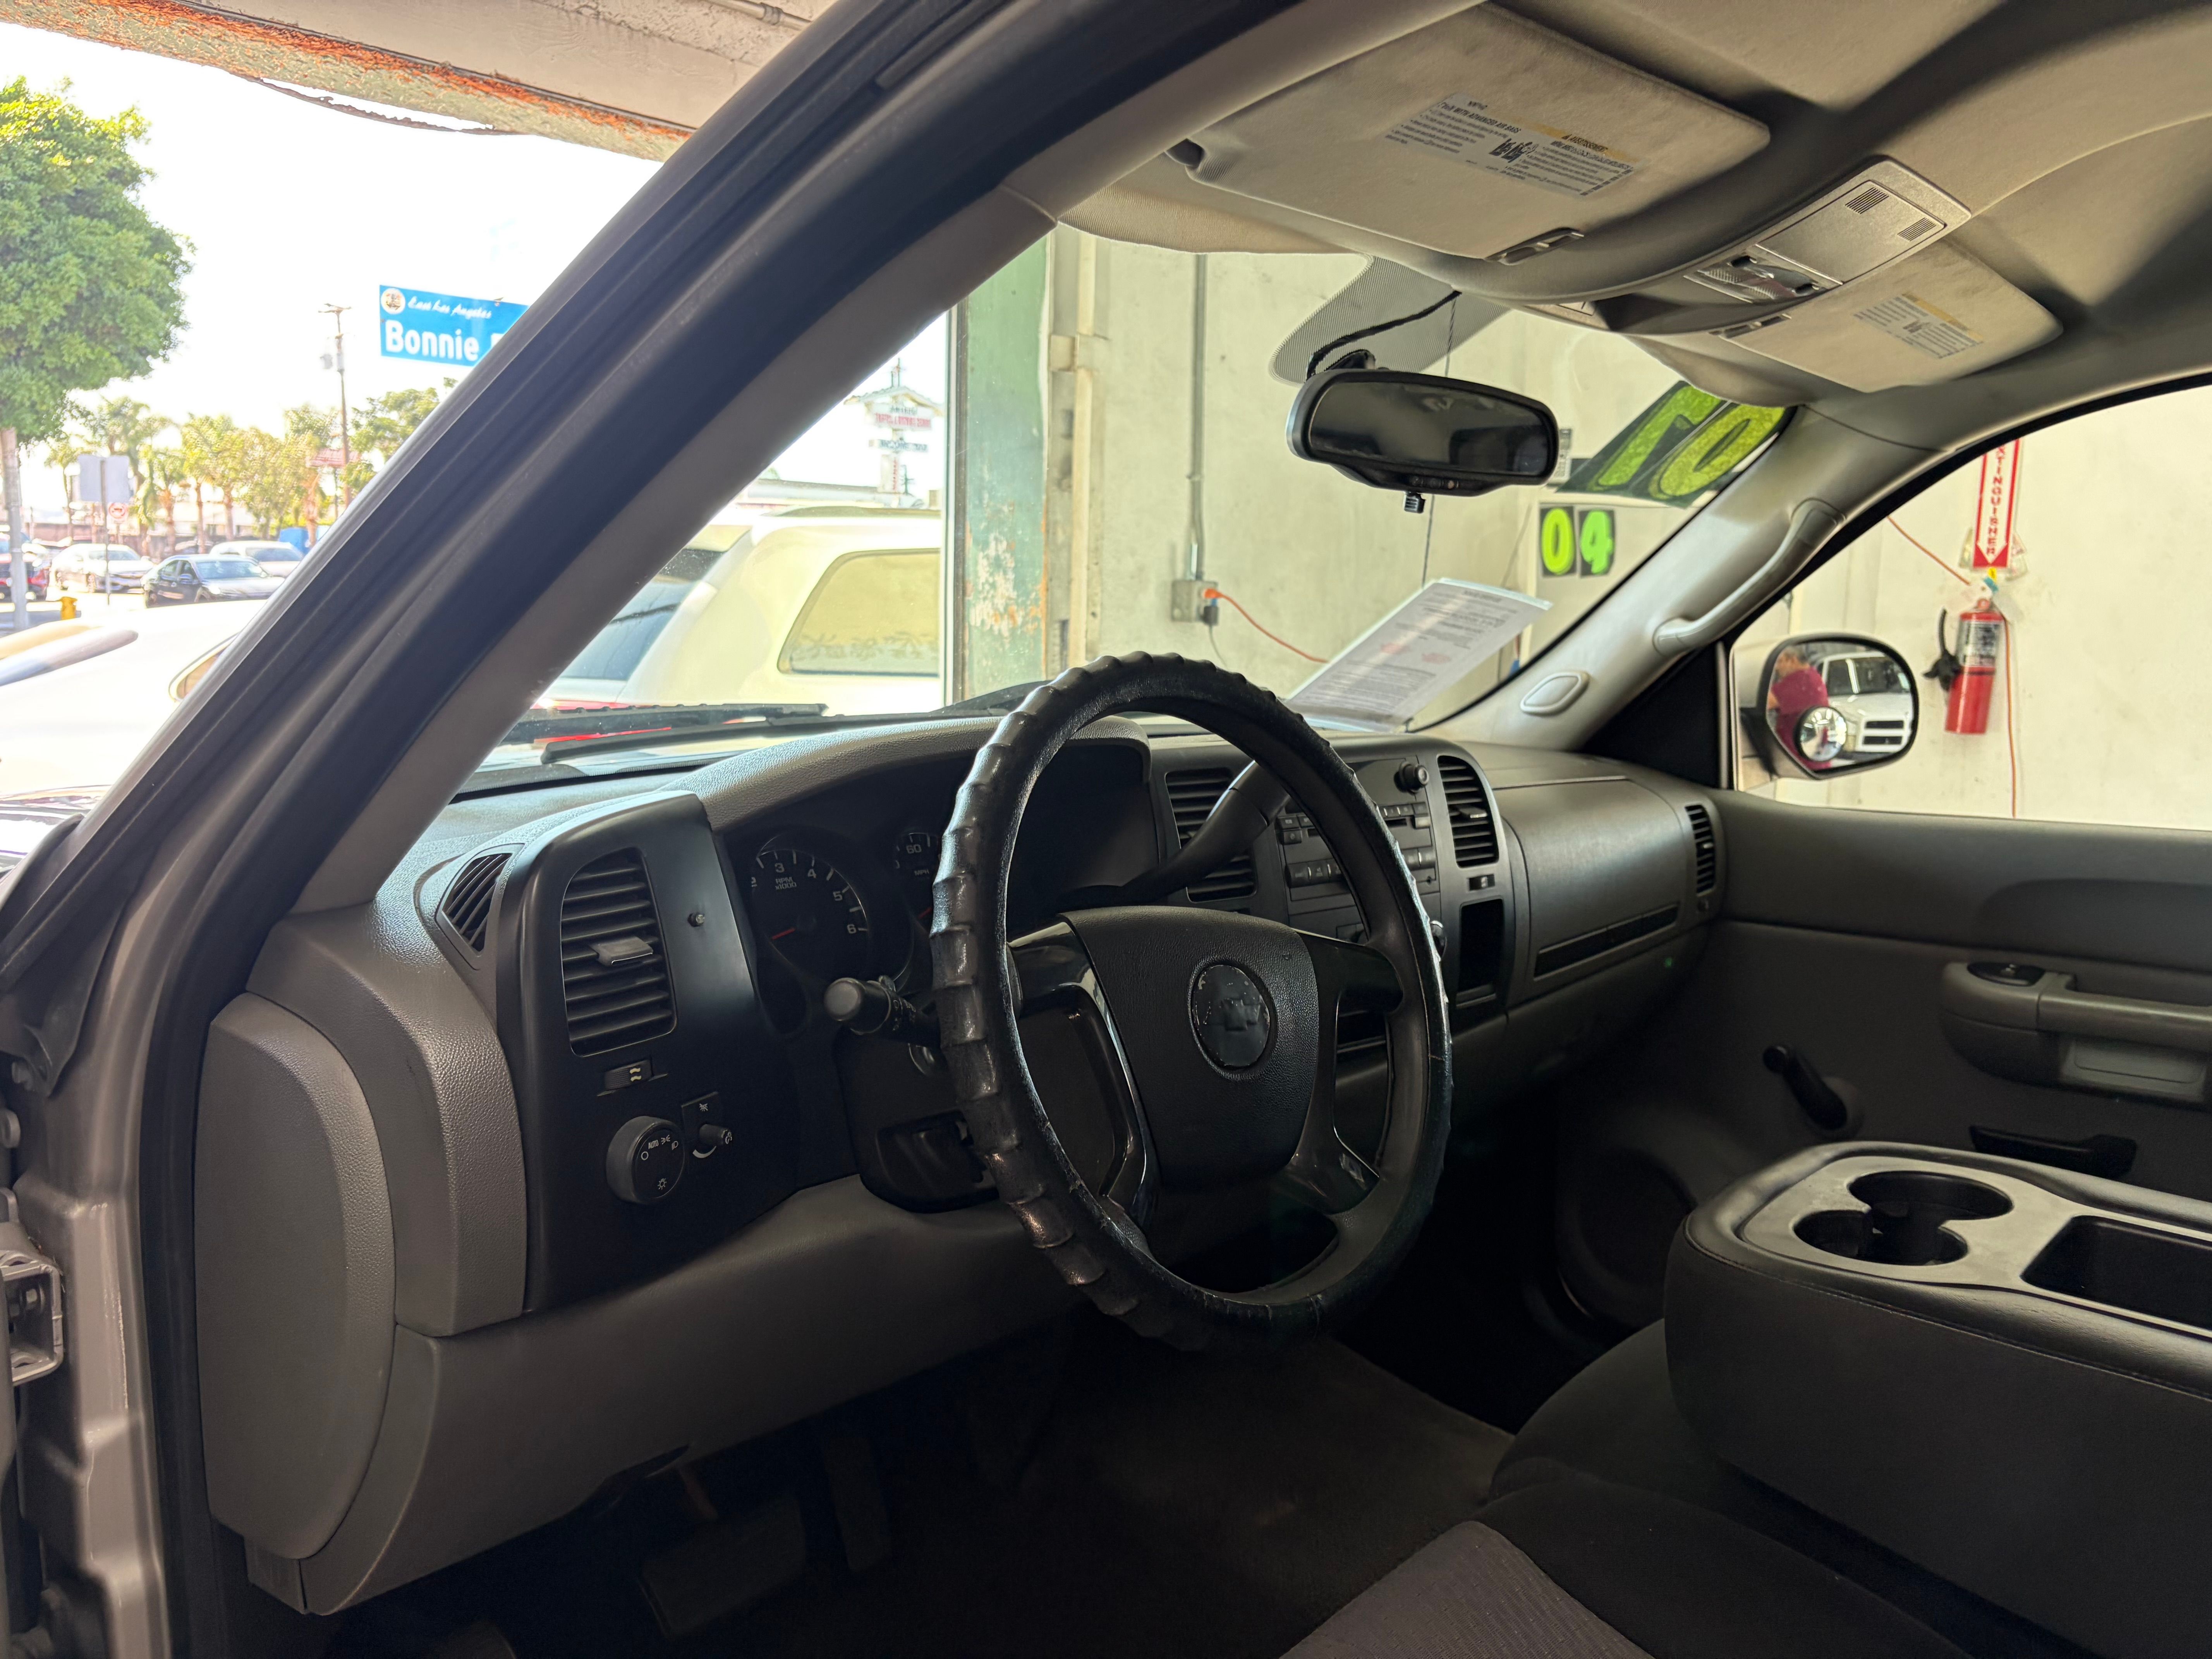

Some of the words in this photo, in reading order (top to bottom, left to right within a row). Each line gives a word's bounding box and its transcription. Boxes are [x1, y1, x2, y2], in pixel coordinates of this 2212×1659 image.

[385, 320, 479, 361] Bonnie
[1986, 445, 2005, 555] XTINGUISHER
[1542, 507, 1613, 575] 04
[906, 844, 922, 854] 60
[775, 863, 785, 873] 3
[807, 869, 817, 879] 4
[833, 891, 843, 901] 5
[847, 924, 857, 934] 6
[648, 1140, 659, 1149] AUTO
